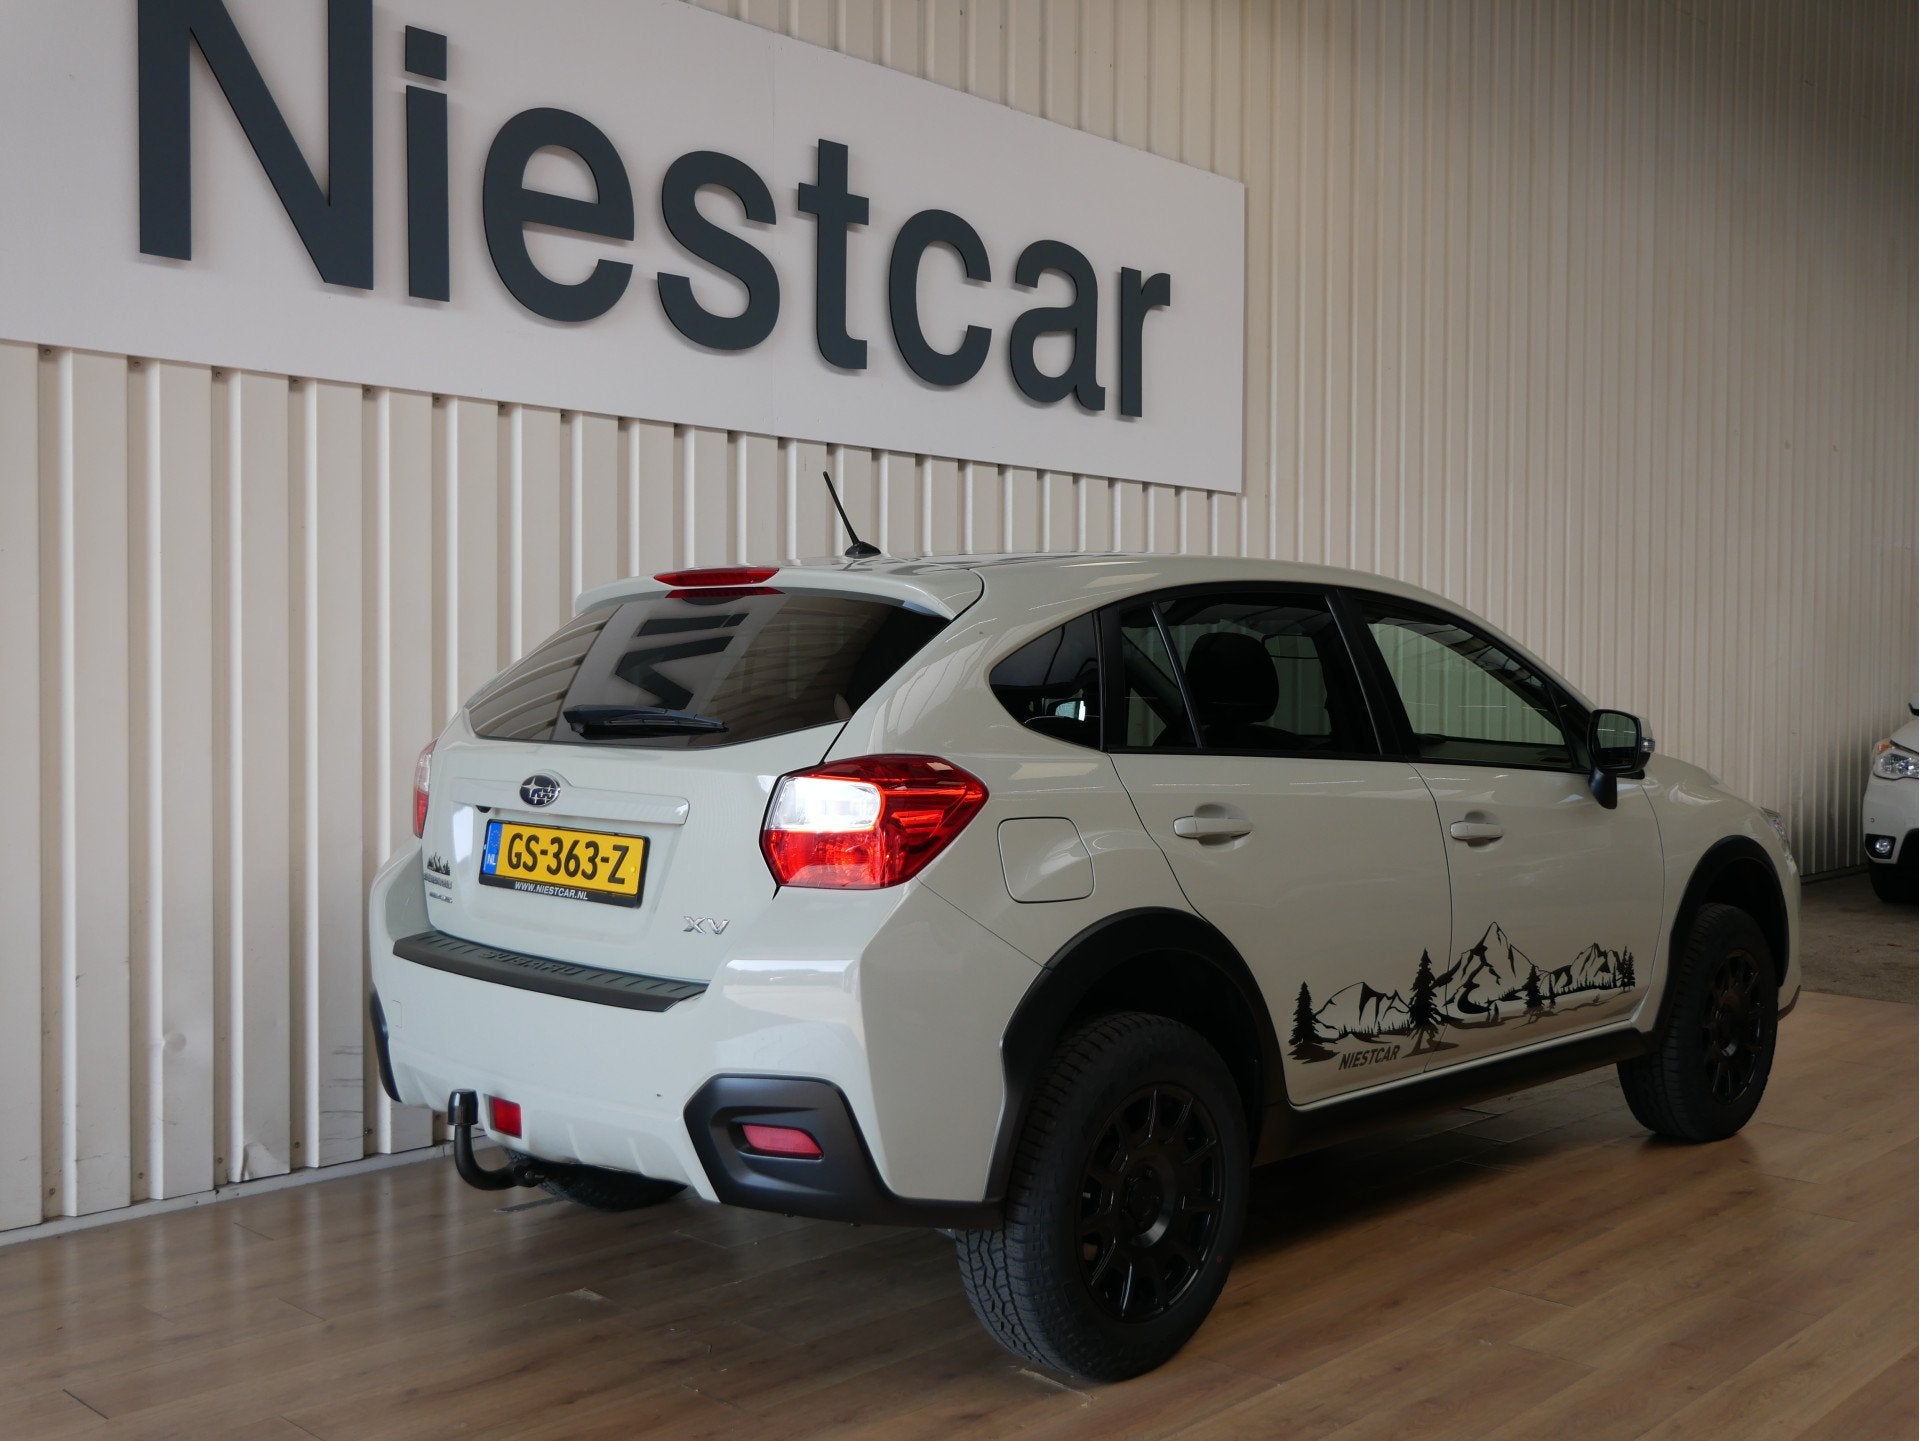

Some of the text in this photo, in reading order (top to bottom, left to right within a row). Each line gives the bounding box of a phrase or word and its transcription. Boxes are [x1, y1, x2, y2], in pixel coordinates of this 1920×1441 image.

[138, 0, 1171, 418] Niestcar
[487, 854, 497, 866] NL
[507, 832, 630, 885] GS-363-Z
[514, 881, 589, 900] WWW.NIESTCAR.NL
[682, 916, 731, 935] XV
[1338, 1044, 1401, 1071] NIESTCAR
